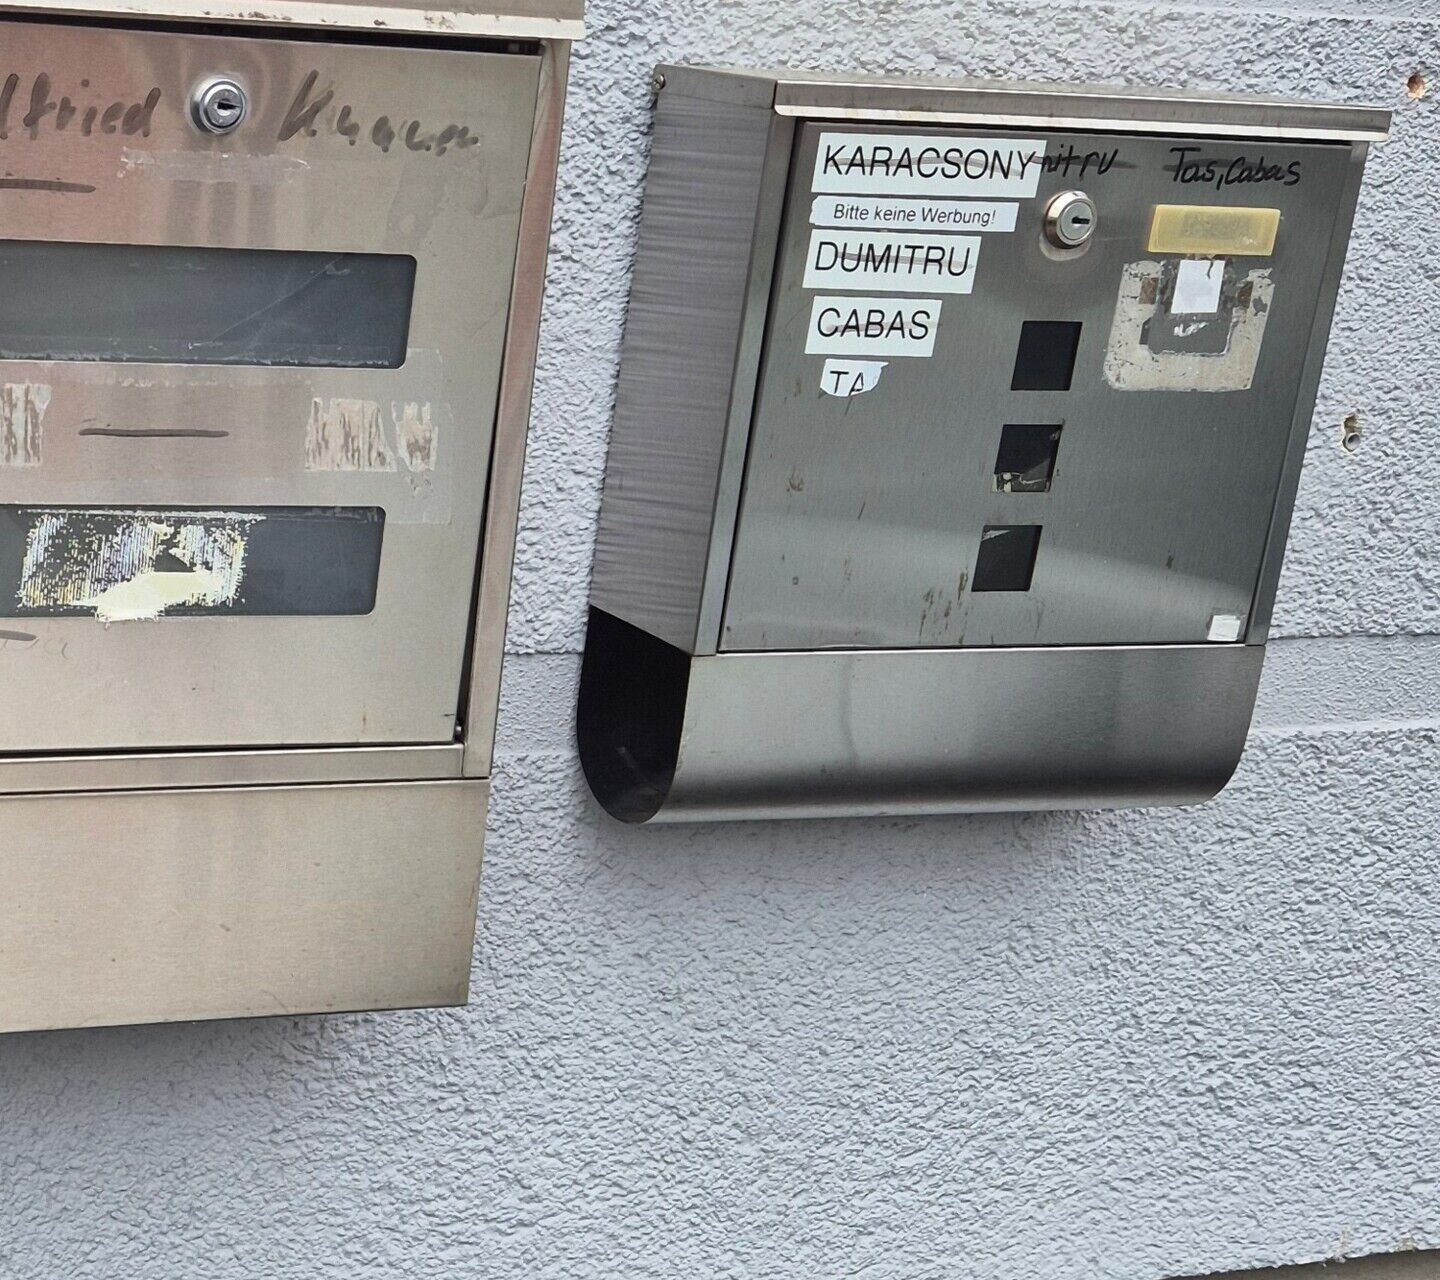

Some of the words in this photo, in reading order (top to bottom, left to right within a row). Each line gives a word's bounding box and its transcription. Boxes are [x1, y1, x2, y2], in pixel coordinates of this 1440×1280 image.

[822, 144, 1037, 180] KARACSONY
[833, 203, 869, 221] Bitte
[874, 206, 917, 222] keine
[921, 207, 996, 227] Werbung!
[815, 241, 971, 277] DUMITRU
[817, 307, 931, 340] CABAS
